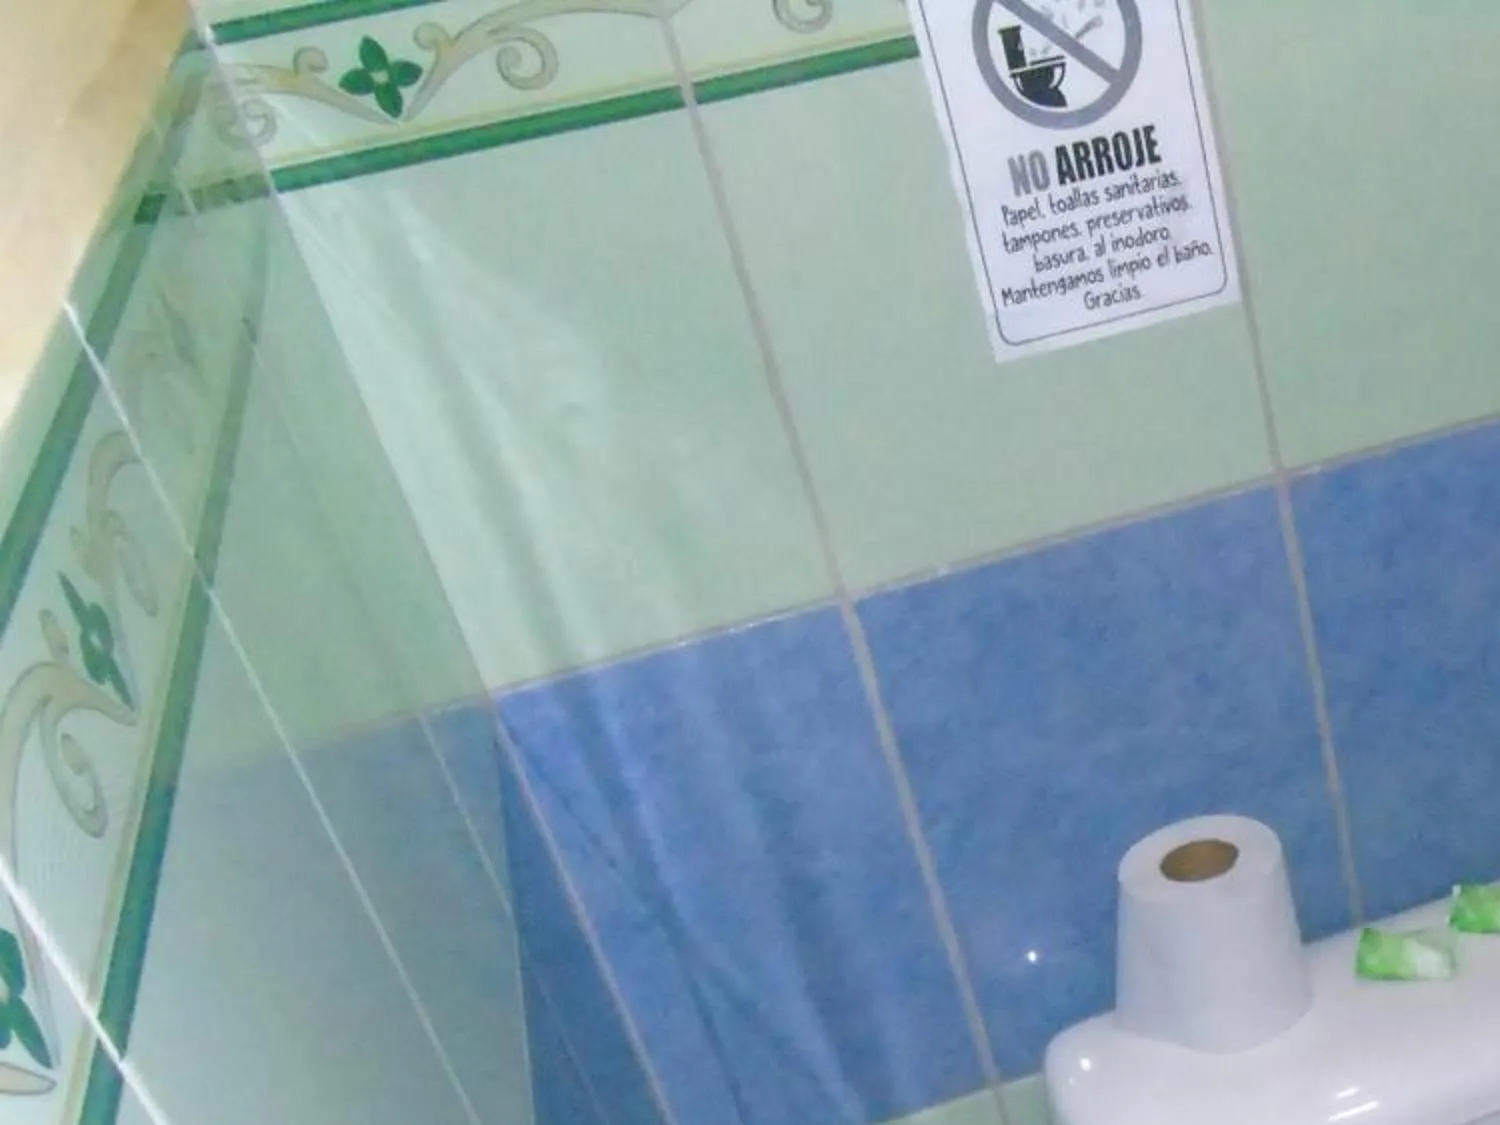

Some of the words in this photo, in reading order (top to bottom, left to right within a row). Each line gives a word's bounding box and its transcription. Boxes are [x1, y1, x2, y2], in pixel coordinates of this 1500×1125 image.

[1007, 150, 1050, 197] NO
[1055, 125, 1162, 185] ARROJE
[1048, 187, 1100, 215] toallas
[1094, 234, 1106, 257] al
[1001, 267, 1104, 307] Mantengamos
[1107, 252, 1151, 280] limpio
[1157, 245, 1169, 268] el
